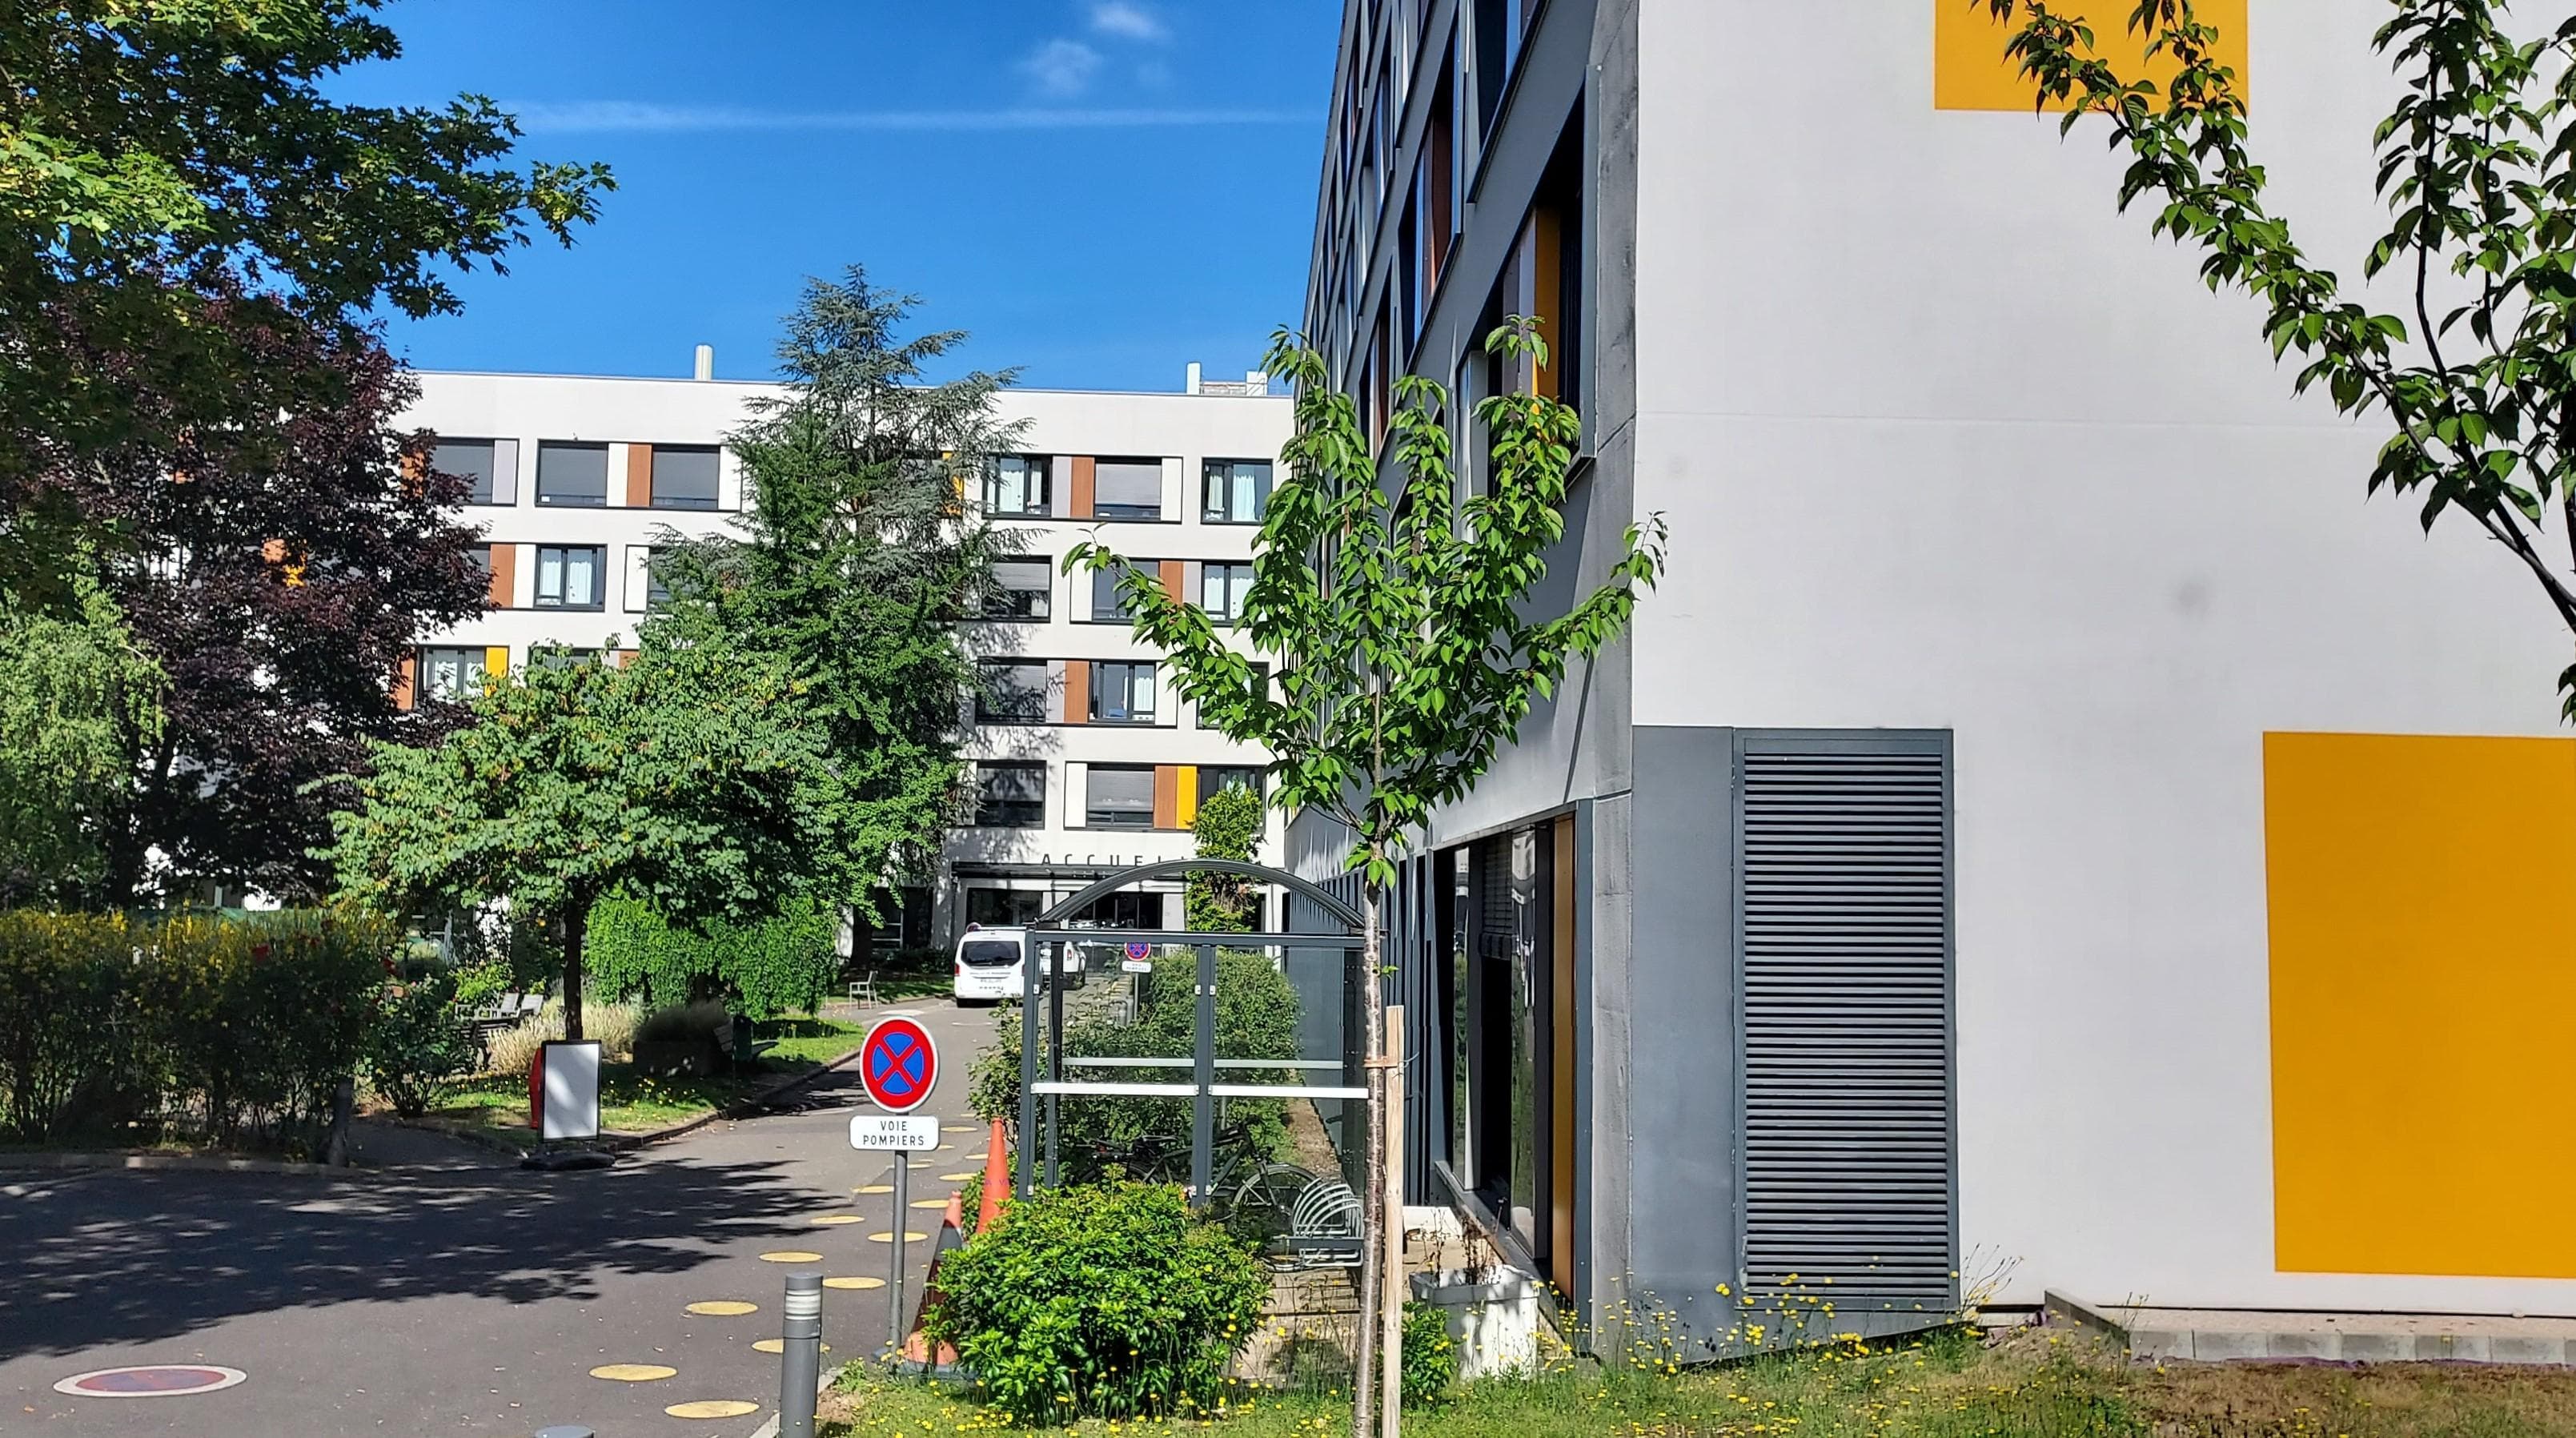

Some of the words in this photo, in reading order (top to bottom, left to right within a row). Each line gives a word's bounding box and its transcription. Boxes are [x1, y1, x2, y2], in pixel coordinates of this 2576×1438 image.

[1041, 854, 1185, 866] ACCUEI
[881, 1120, 908, 1131] VOIE
[863, 1135, 925, 1146] POMPIERS
